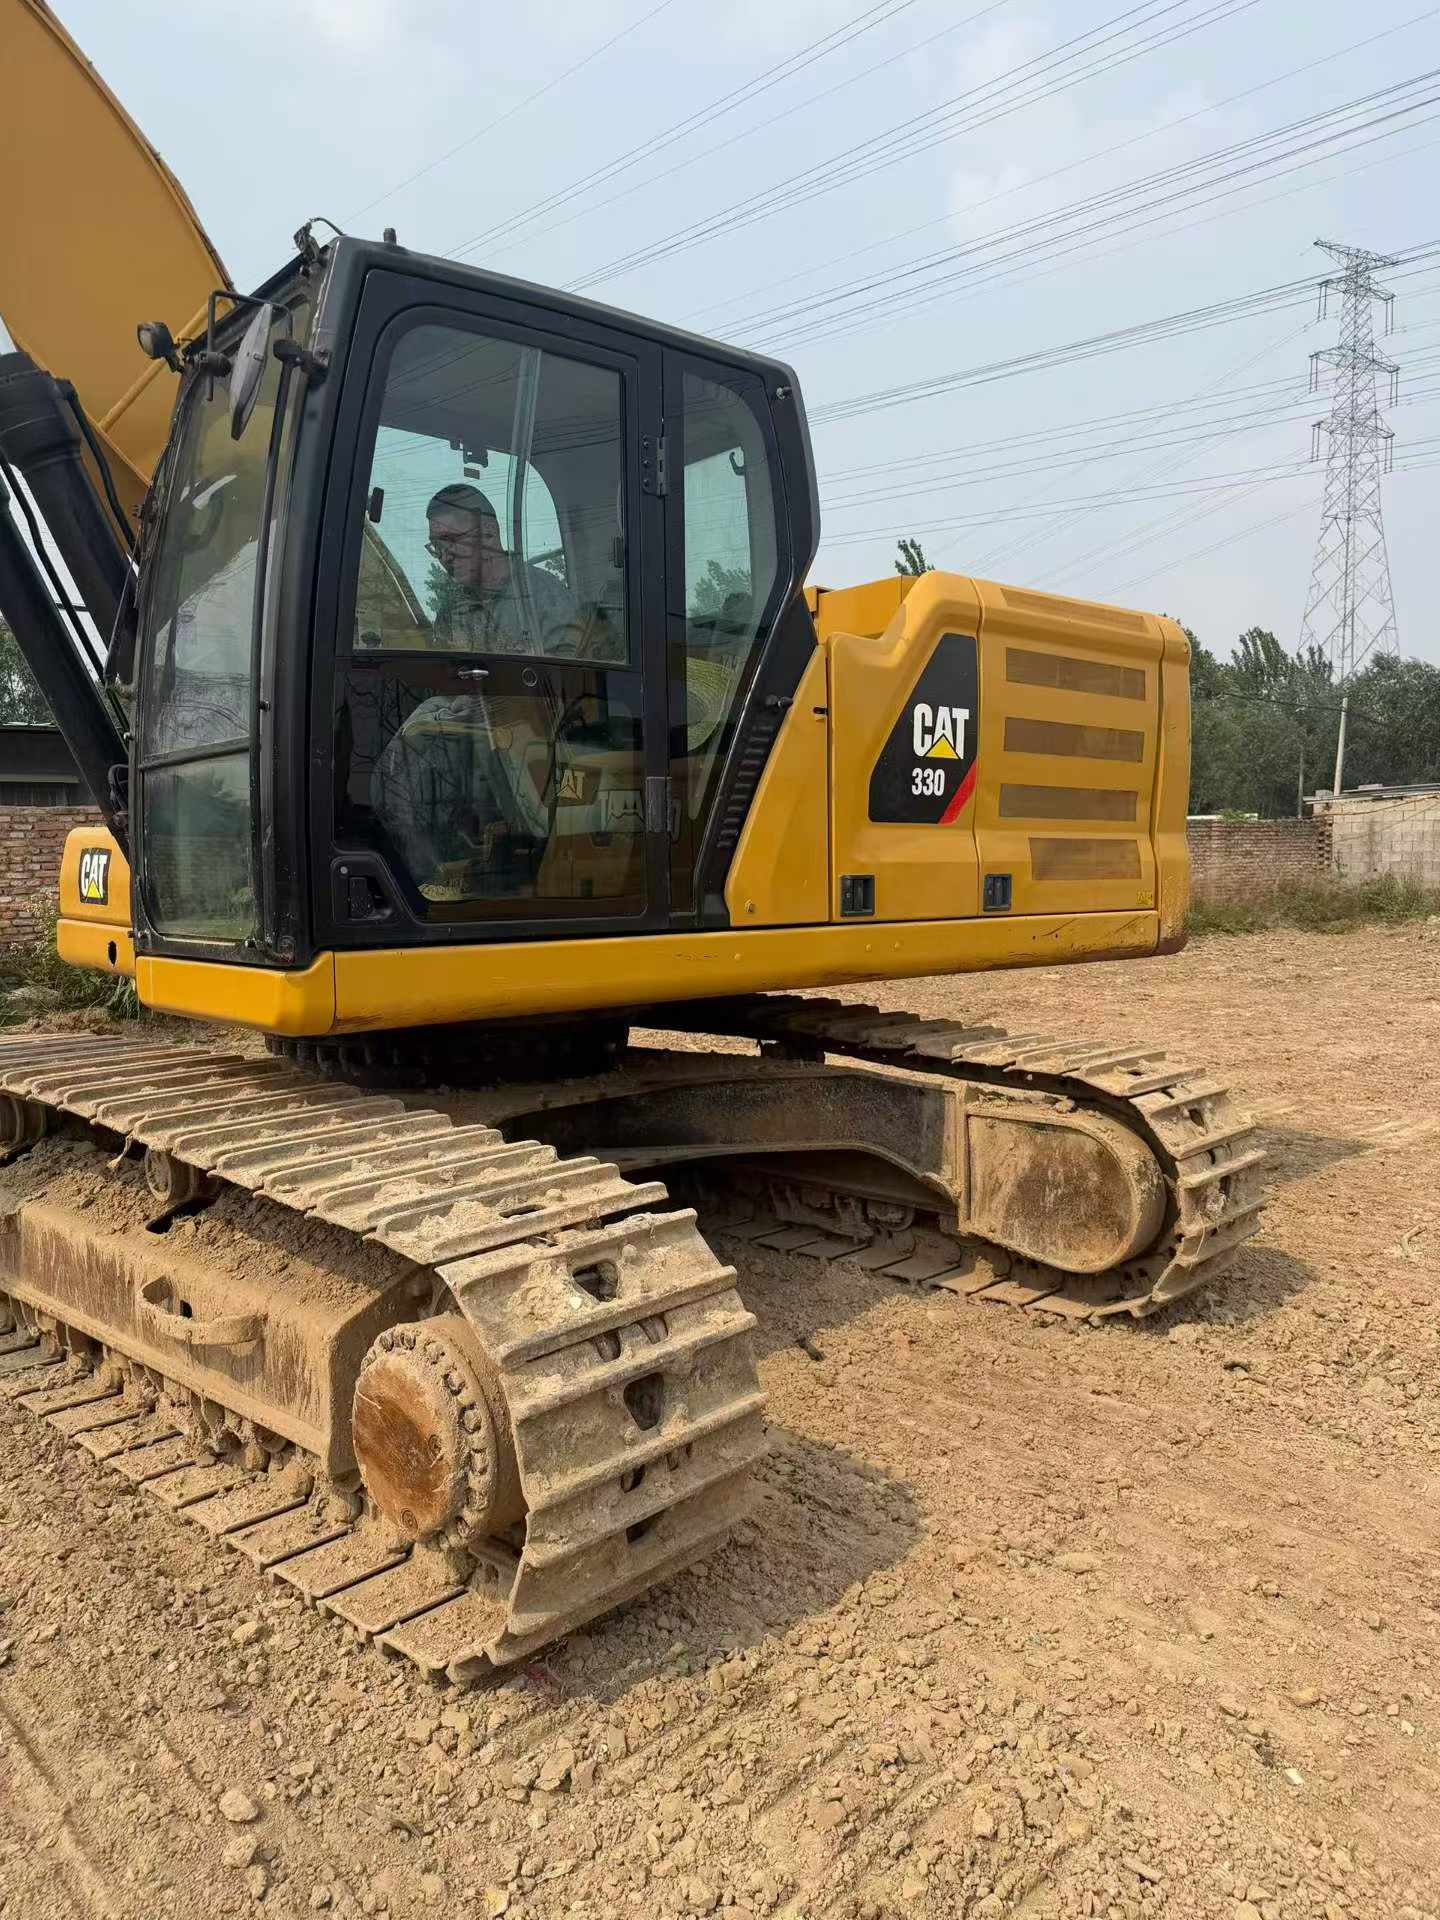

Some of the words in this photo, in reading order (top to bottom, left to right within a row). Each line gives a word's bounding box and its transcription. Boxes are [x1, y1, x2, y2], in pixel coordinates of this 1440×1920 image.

[913, 702, 970, 760] CAT
[555, 768, 586, 801] AT
[911, 767, 946, 797] 330
[80, 853, 108, 899] CAT
